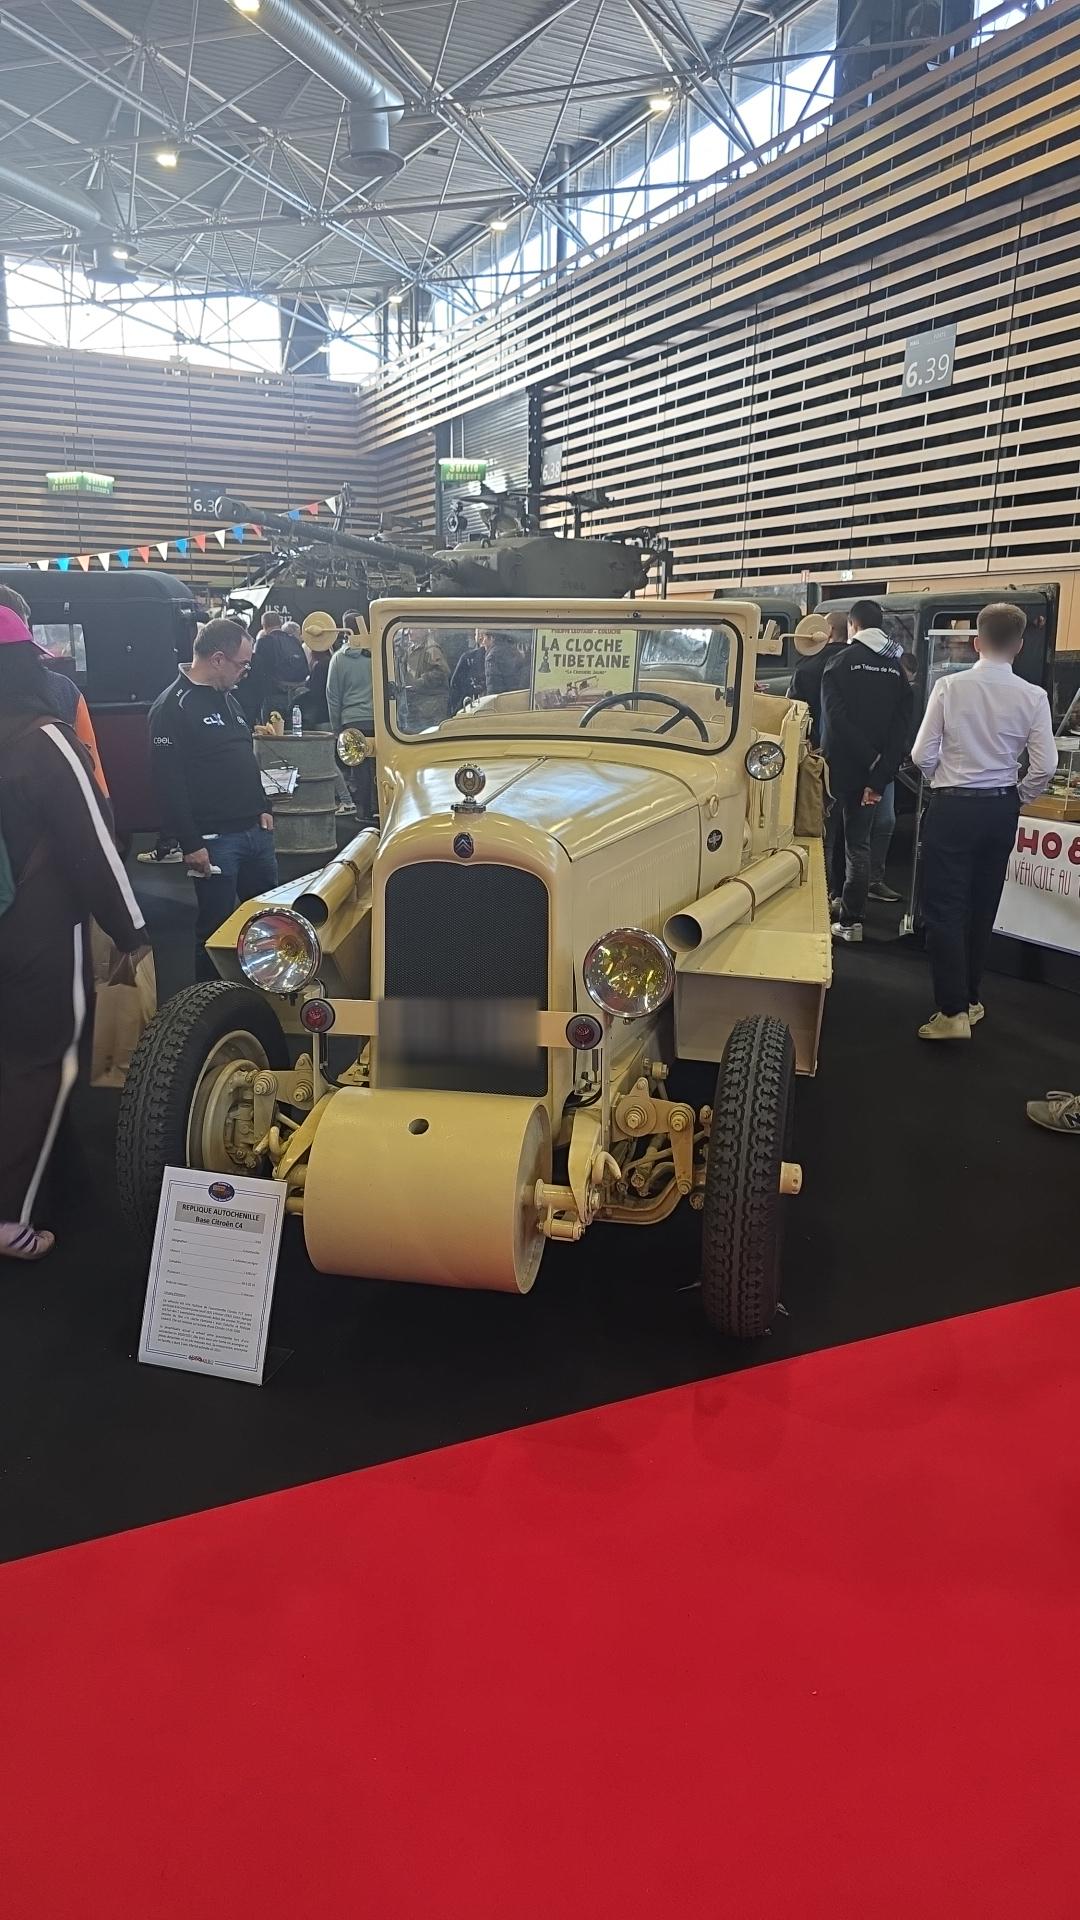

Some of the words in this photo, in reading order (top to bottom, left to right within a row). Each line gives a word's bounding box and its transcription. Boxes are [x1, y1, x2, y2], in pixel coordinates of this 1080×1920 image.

[905, 353, 950, 389] 6.39
[542, 461, 561, 481] 6.38
[193, 499, 215, 512] 6.3
[265, 604, 290, 614] US.A.
[541, 635, 560, 652] LA
[565, 638, 623, 653] CLOCHE
[553, 653, 631, 669] TIBETAINE
[1014, 856, 1056, 893] VÉHICULE
[1058, 869, 1072, 896] AU
[181, 1203, 213, 1215] REPLIQUE
[213, 1208, 260, 1221] AUTOCHENILLE
[195, 1216, 210, 1225] Base
[234, 1221, 243, 1229] C4
